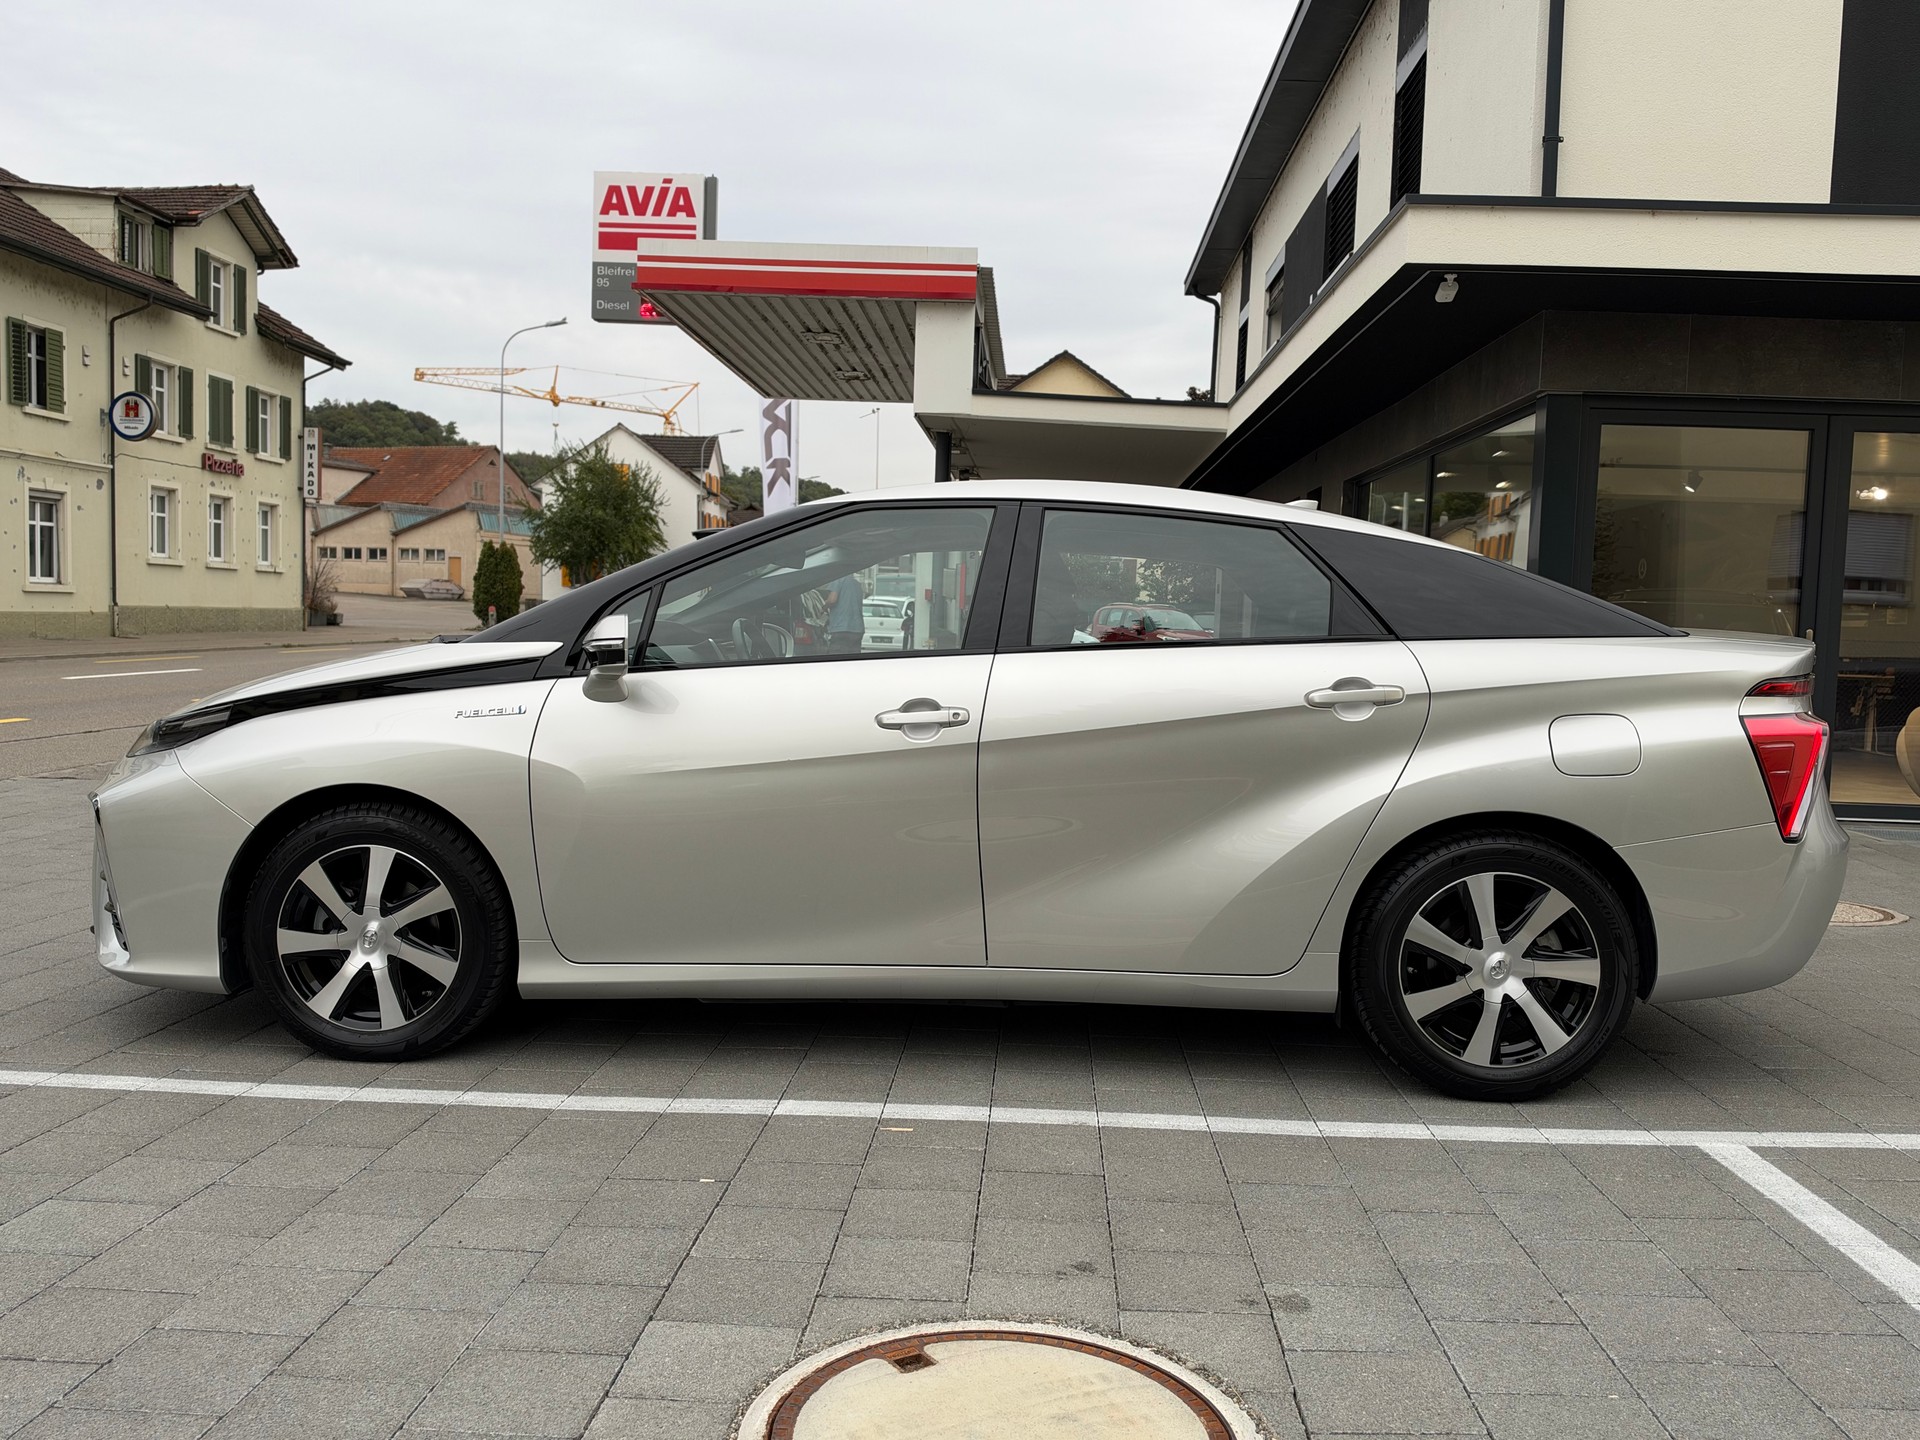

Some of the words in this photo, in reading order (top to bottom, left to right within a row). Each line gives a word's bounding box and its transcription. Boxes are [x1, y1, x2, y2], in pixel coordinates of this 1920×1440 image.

[596, 265, 635, 277] Bleifrei
[596, 278, 610, 288] 95
[596, 300, 630, 311] Diesel
[204, 453, 245, 477] Pizzeria
[307, 444, 316, 496] MIKADO
